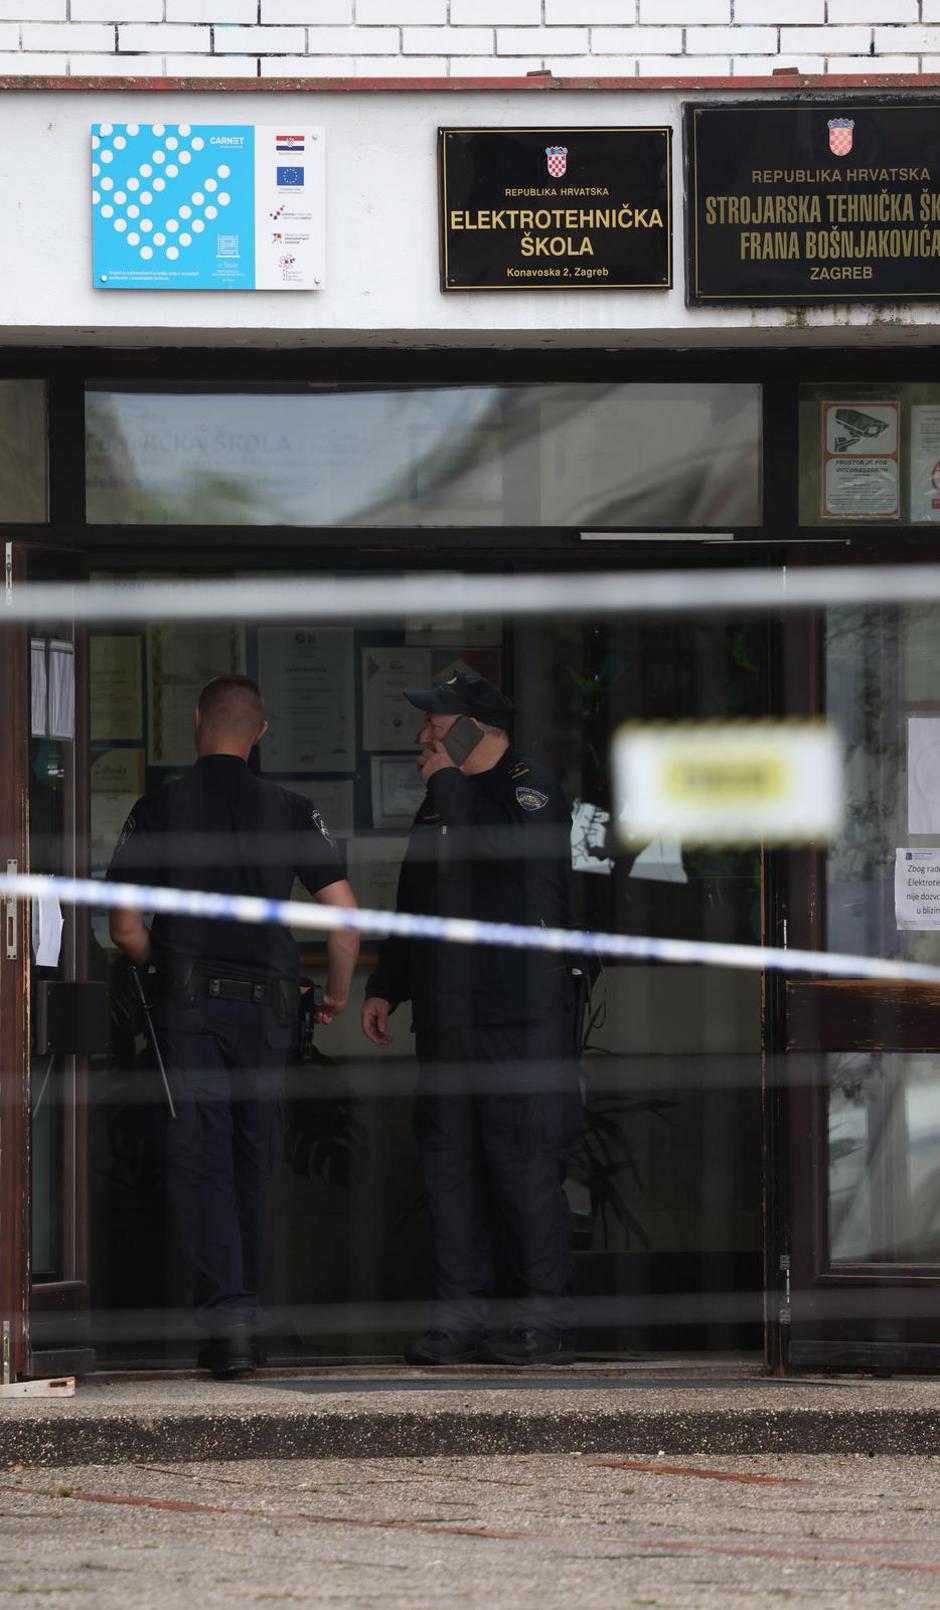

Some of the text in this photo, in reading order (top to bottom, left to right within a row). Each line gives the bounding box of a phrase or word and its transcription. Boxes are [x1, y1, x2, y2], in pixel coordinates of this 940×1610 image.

[210, 136, 244, 145] CARNET
[752, 167, 931, 184] REPUBLIKA HRVATSKA
[505, 187, 609, 197] REPUBLIKA HRVATSKA
[705, 195, 821, 225] STROJARSKA
[826, 188, 914, 223] TEHNIČKA
[450, 203, 663, 230] ELEKTROTEHNIČKA
[520, 232, 594, 256] ŠKOLA
[740, 224, 940, 260] FRANA BOŠNJAKOVIĆA
[506, 267, 609, 279] Konavoska 2, Zagreb
[809, 266, 873, 281] ZAGREB
[907, 865, 926, 874] Zbog
[907, 879, 940, 887] Elektrote
[906, 893, 920, 902] nije
